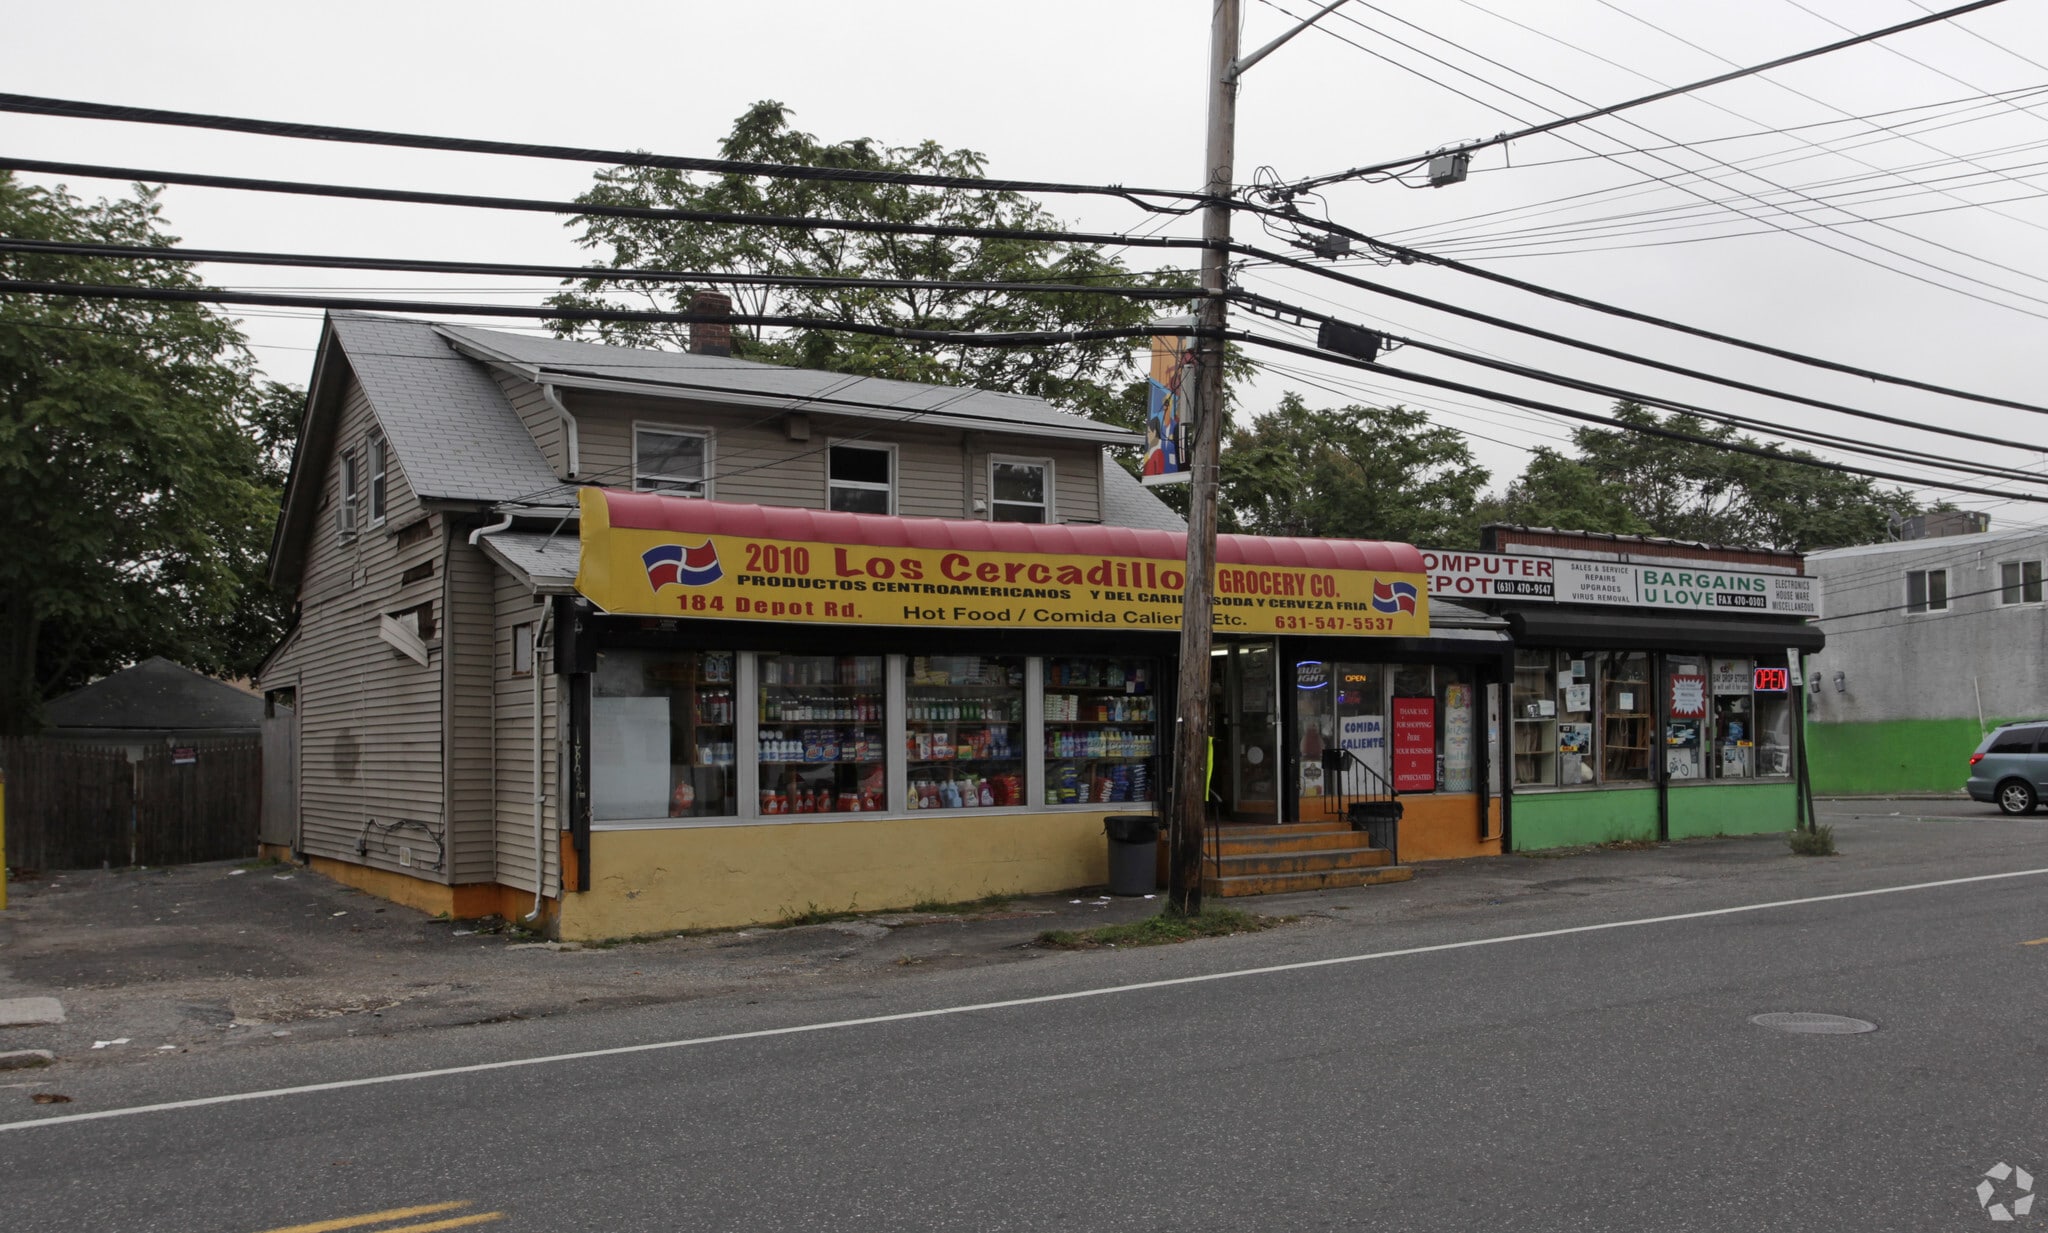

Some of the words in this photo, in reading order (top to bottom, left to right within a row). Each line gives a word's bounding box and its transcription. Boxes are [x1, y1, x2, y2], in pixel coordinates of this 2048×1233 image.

[745, 543, 810, 576] 2010
[834, 547, 924, 580] Los
[1218, 569, 1306, 596] GROCERY
[1310, 574, 1341, 598] CO.
[1421, 553, 1553, 577] OMPUTER
[1571, 563, 1592, 572] SALES
[1602, 565, 1629, 574] SERVICE
[1585, 573, 1616, 582] REPAIRS
[1643, 570, 1766, 592] BARGAINS
[1496, 581, 1515, 593] (631)
[1516, 582, 1551, 595] 470-9547
[1580, 583, 1621, 593] UPGRADES
[1775, 579, 1810, 590] ELECTRONICS
[737, 575, 867, 591] PRODUCTOS
[872, 582, 1071, 599] CENTROAMERICANOS
[1090, 590, 1100, 600] Y
[1105, 591, 1135, 602] DEL
[1213, 597, 1254, 607] SODA
[1256, 598, 1265, 607] Y
[1269, 598, 1334, 610] CERVEZA
[1337, 601, 1368, 611] FRIA
[1572, 593, 1594, 601] VIRUS
[1597, 594, 1630, 603] REMOVAL
[1644, 588, 1657, 603] U
[1663, 589, 1715, 606] LOVE
[1776, 590, 1793, 600] HOUSE
[1794, 591, 1810, 601] WARE
[676, 594, 725, 612] 184
[735, 597, 814, 616] Depot
[824, 601, 863, 618] Rd.
[1718, 594, 1733, 605] FAX
[1734, 595, 1765, 607] 470-0302
[1772, 601, 1815, 612] MISCELLANEOUS
[903, 606, 946, 620] Hot
[953, 607, 1011, 621] Food
[1017, 608, 1026, 622] /
[1033, 609, 1116, 624] Comida
[1212, 613, 1248, 626] Etc.
[1275, 616, 1394, 631] 631-547-5537
[1345, 674, 1367, 682] OPEN
[1755, 669, 1787, 690] OPEN
[1344, 721, 1380, 734] COMIDA
[1341, 737, 1385, 750] CALIENTE
